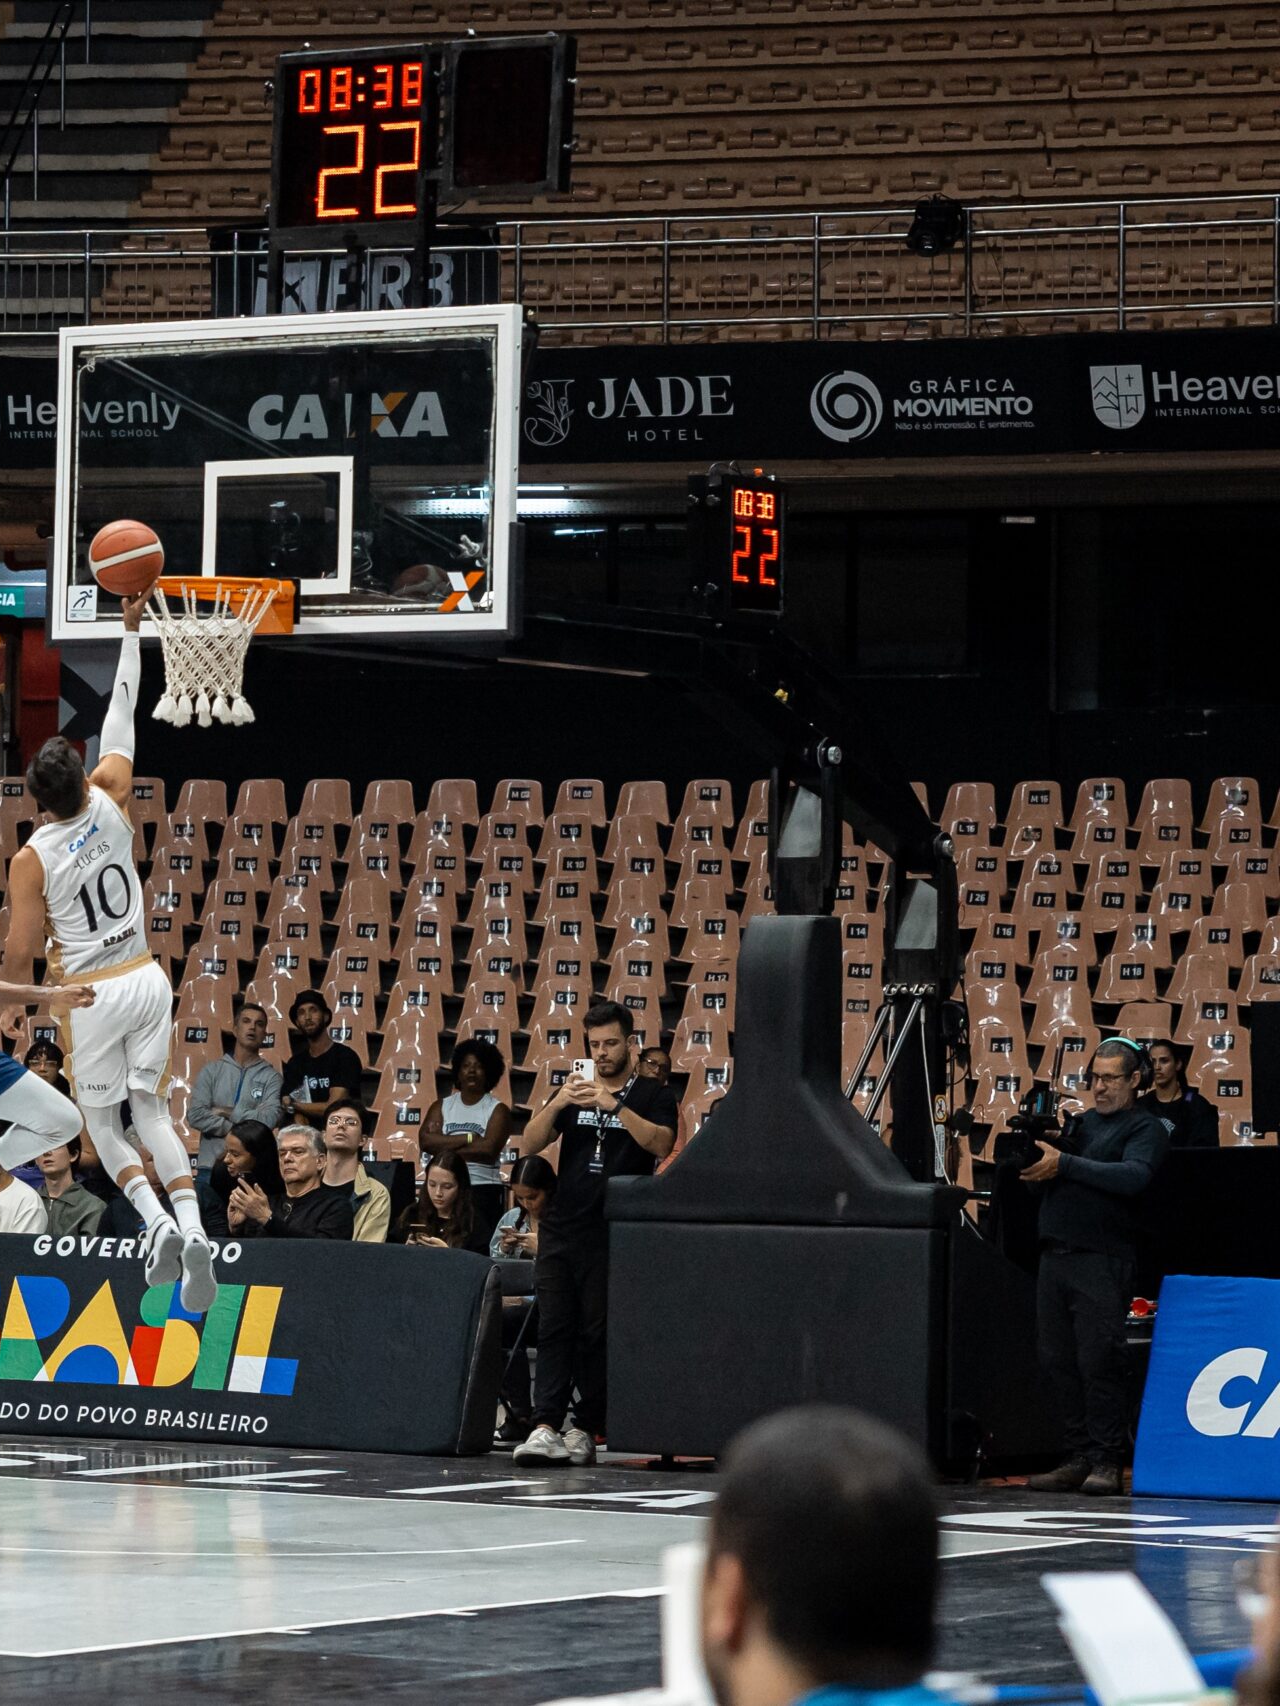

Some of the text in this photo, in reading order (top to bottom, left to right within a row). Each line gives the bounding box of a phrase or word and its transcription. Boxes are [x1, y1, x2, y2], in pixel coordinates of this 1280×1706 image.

[299, 63, 423, 113] 08:38
[317, 121, 421, 217] 22
[909, 377, 1015, 393] GRÁFICA
[1152, 371, 1280, 403] Heave
[587, 375, 734, 419] JADE
[7, 392, 181, 430] Hevenly
[893, 396, 1033, 417] MOVIMENTO
[1155, 406, 1252, 417] INTERNATIONAL
[895, 422, 913, 430] Não
[922, 421, 932, 430] só
[111, 428, 159, 438] SCHOOL
[627, 429, 704, 442] HOTEL
[732, 526, 778, 586] 22
[5, 786, 21, 794] C 01
[496, 827, 514, 835] L 09
[959, 824, 975, 833] L 16
[1096, 831, 1113, 839] L 18
[1231, 831, 1249, 840] L 20
[74, 840, 111, 870] LUCAS
[436, 859, 455, 867] K 08
[503, 860, 522, 869] K 09
[567, 860, 585, 868] K 10
[702, 863, 719, 872] K 12
[977, 860, 995, 869] K 16
[1247, 862, 1267, 871] K 20
[1109, 865, 1127, 873] K 18
[1181, 864, 1199, 873] K 19
[559, 886, 575, 895] J 10
[73, 863, 131, 933] 10
[227, 894, 243, 903] J 05
[970, 893, 986, 902] J 26
[1036, 896, 1052, 905] J 17
[347, 961, 354, 969] H
[420, 961, 440, 970] H 08
[559, 964, 578, 973] H 10
[851, 967, 871, 976] H 14
[984, 966, 1002, 974] H 16
[1122, 967, 1142, 976] H 18
[626, 998, 632, 1006] G
[706, 998, 724, 1007] G 12
[848, 1002, 854, 1010] G
[36, 1030, 55, 1038] F 03
[188, 1030, 207, 1039] F 05
[1220, 1086, 1239, 1095] E 19
[38, 1403, 69, 1422] DO
[77, 1406, 137, 1425] POVO
[144, 1409, 269, 1434] BRASILEIRO
